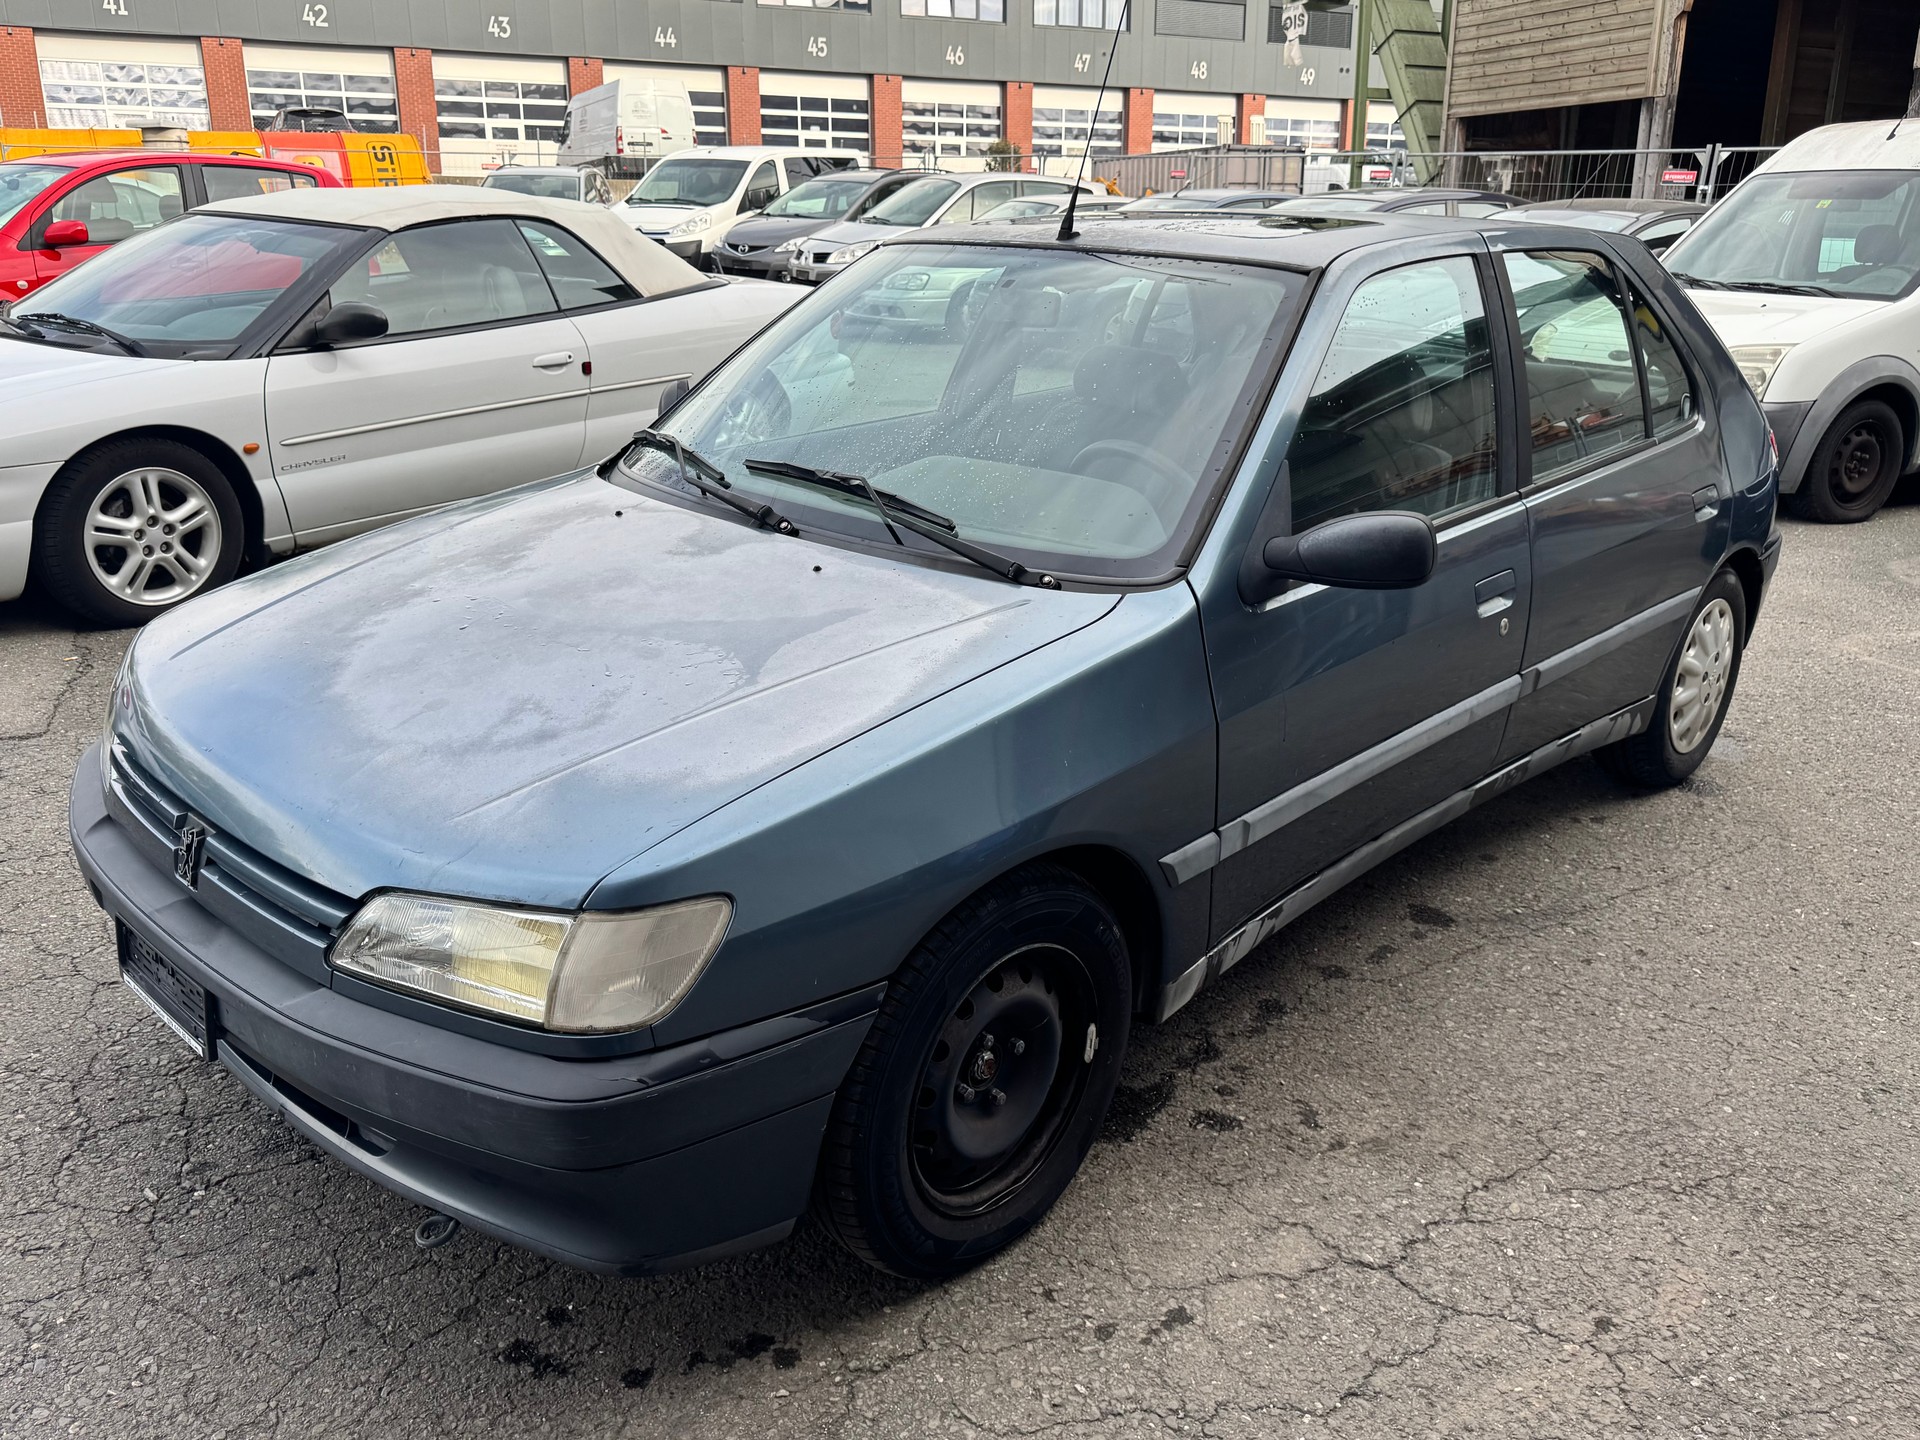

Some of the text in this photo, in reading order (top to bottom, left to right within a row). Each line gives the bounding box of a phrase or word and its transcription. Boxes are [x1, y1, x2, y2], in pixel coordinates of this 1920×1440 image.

[103, 0, 128, 15] 41
[303, 4, 328, 27] 42
[488, 16, 510, 38] 43
[654, 26, 677, 48] 44
[808, 37, 827, 57] 45
[945, 45, 964, 66] 46
[1074, 54, 1090, 73] 47
[1191, 61, 1207, 80] 48
[1299, 68, 1315, 85] 49
[281, 454, 346, 471] CHRYSLER
